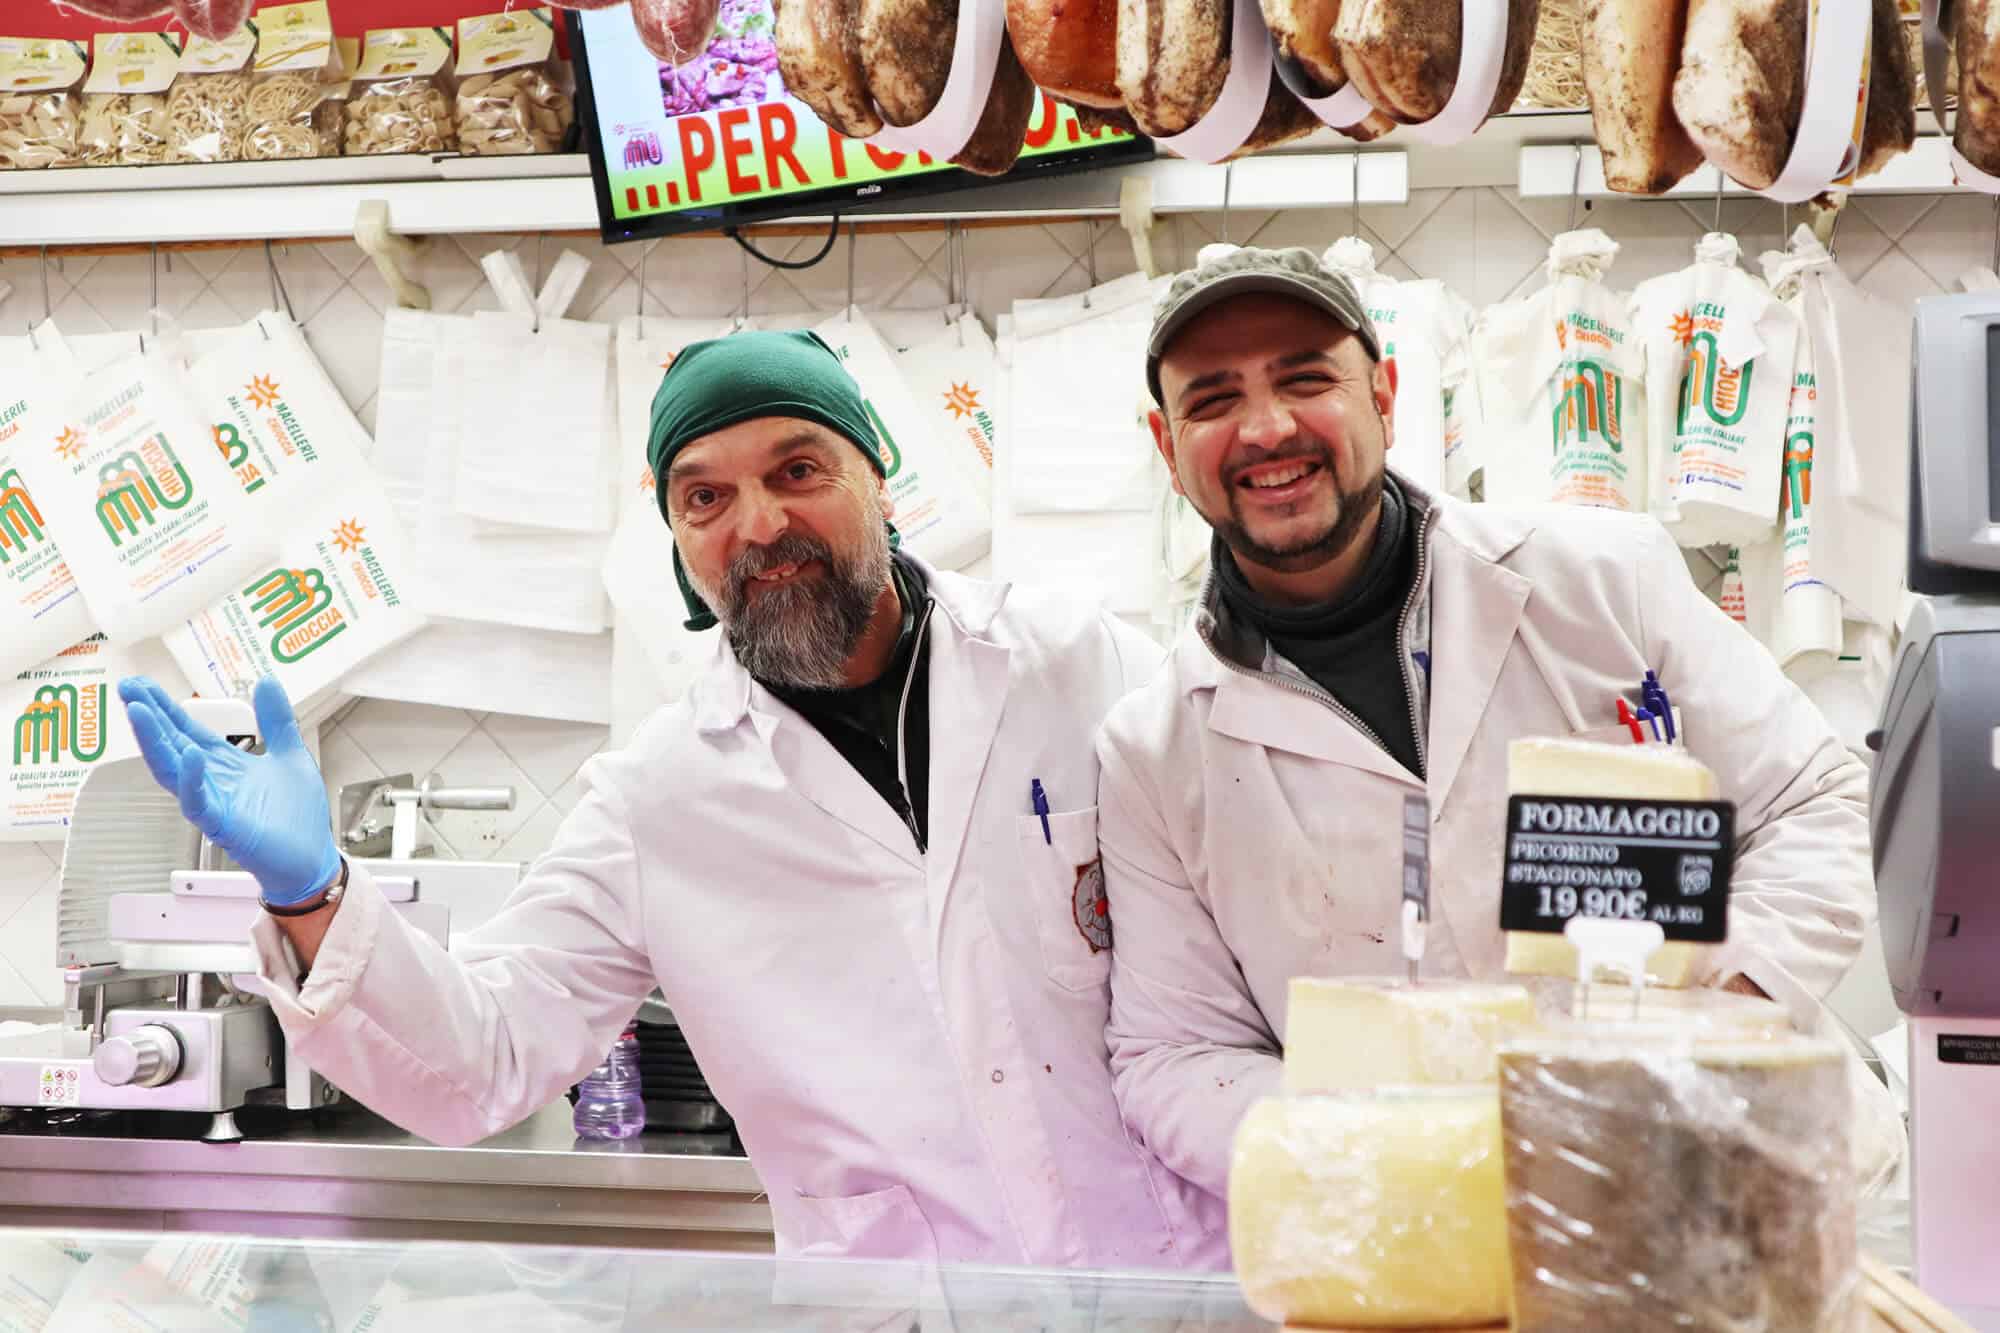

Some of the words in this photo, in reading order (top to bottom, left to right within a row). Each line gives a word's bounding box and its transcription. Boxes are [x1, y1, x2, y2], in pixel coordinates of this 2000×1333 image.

[275, 401, 318, 463] MACELLERIE
[358, 547, 400, 608] MACELLERIE
[1519, 802, 1721, 838] FORMAGGIO
[1510, 840, 1620, 864] PECORINO
[1509, 863, 1643, 888] STAGIONATO
